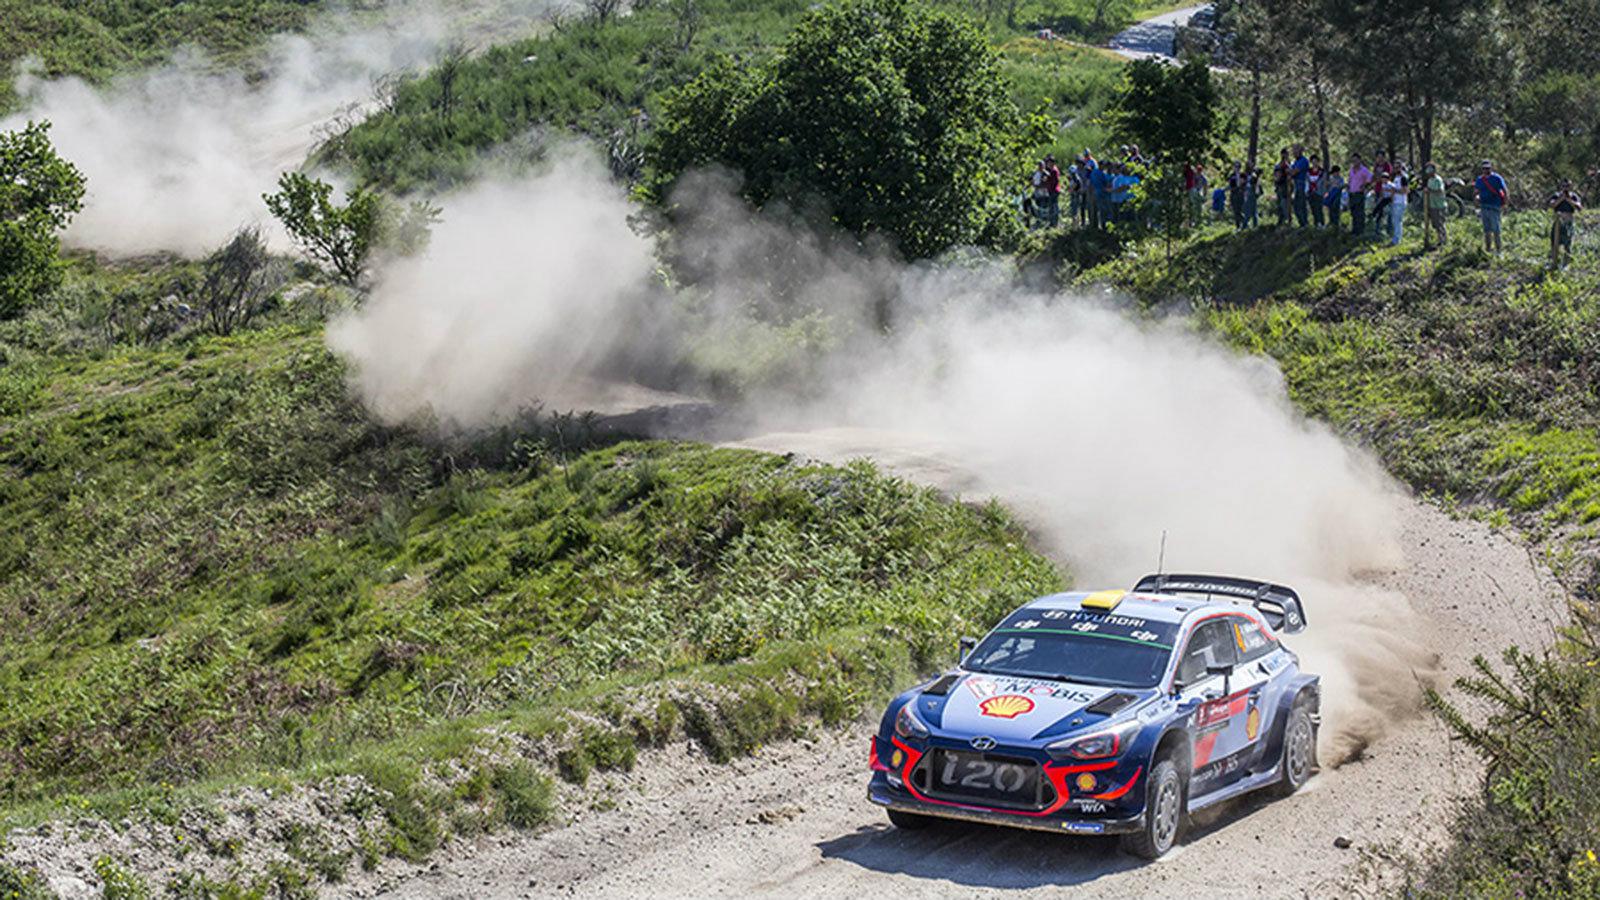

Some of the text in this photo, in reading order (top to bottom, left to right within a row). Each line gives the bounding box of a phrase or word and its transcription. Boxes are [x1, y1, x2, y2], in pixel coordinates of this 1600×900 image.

[1069, 611, 1146, 628] HYUNDAI
[1004, 683, 1094, 703] MOBIS
[941, 750, 1026, 792] i20
